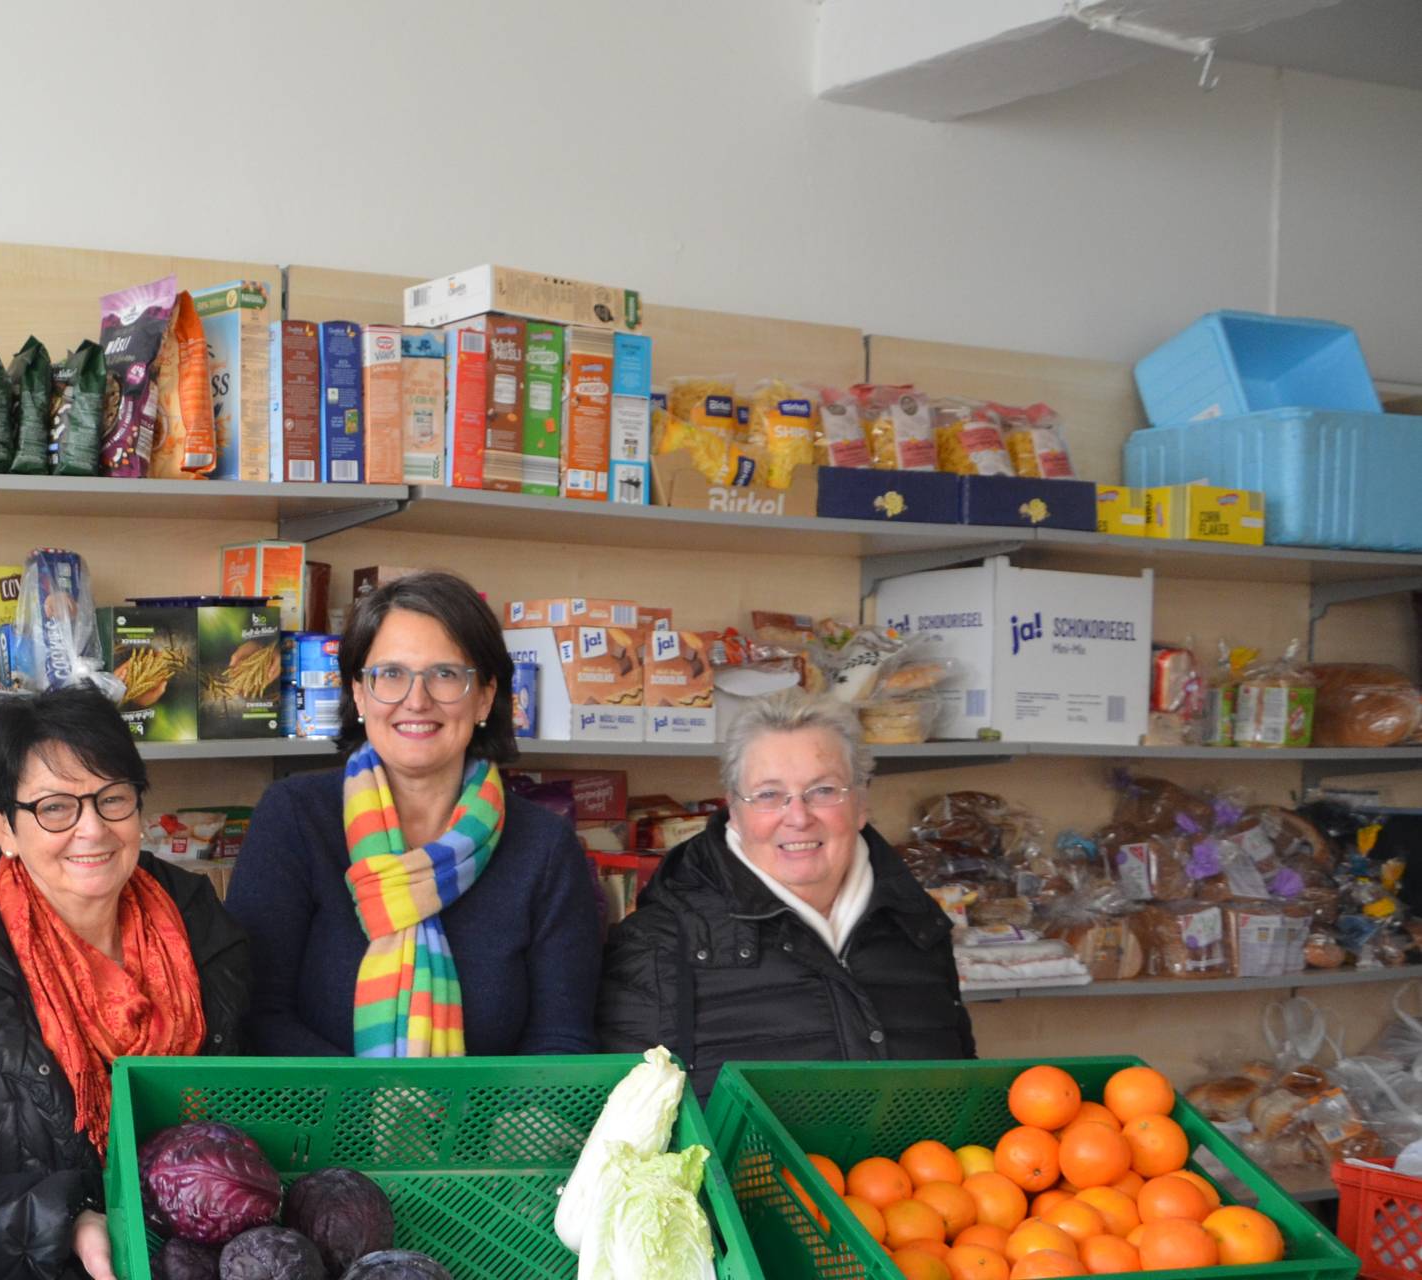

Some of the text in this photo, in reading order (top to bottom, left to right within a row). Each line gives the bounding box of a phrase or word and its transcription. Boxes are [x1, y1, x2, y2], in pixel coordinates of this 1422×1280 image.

[210, 373, 231, 397] SS
[708, 487, 786, 515] Birkel
[252, 612, 267, 624] bio
[917, 612, 984, 631] SCHOKORIEGEL
[582, 631, 602, 653] ja!
[1010, 612, 1137, 655] ja! SCHOKORIEGEL
[657, 635, 675, 656] ja!
[580, 712, 596, 730] ja!
[654, 715, 669, 732] ja!
